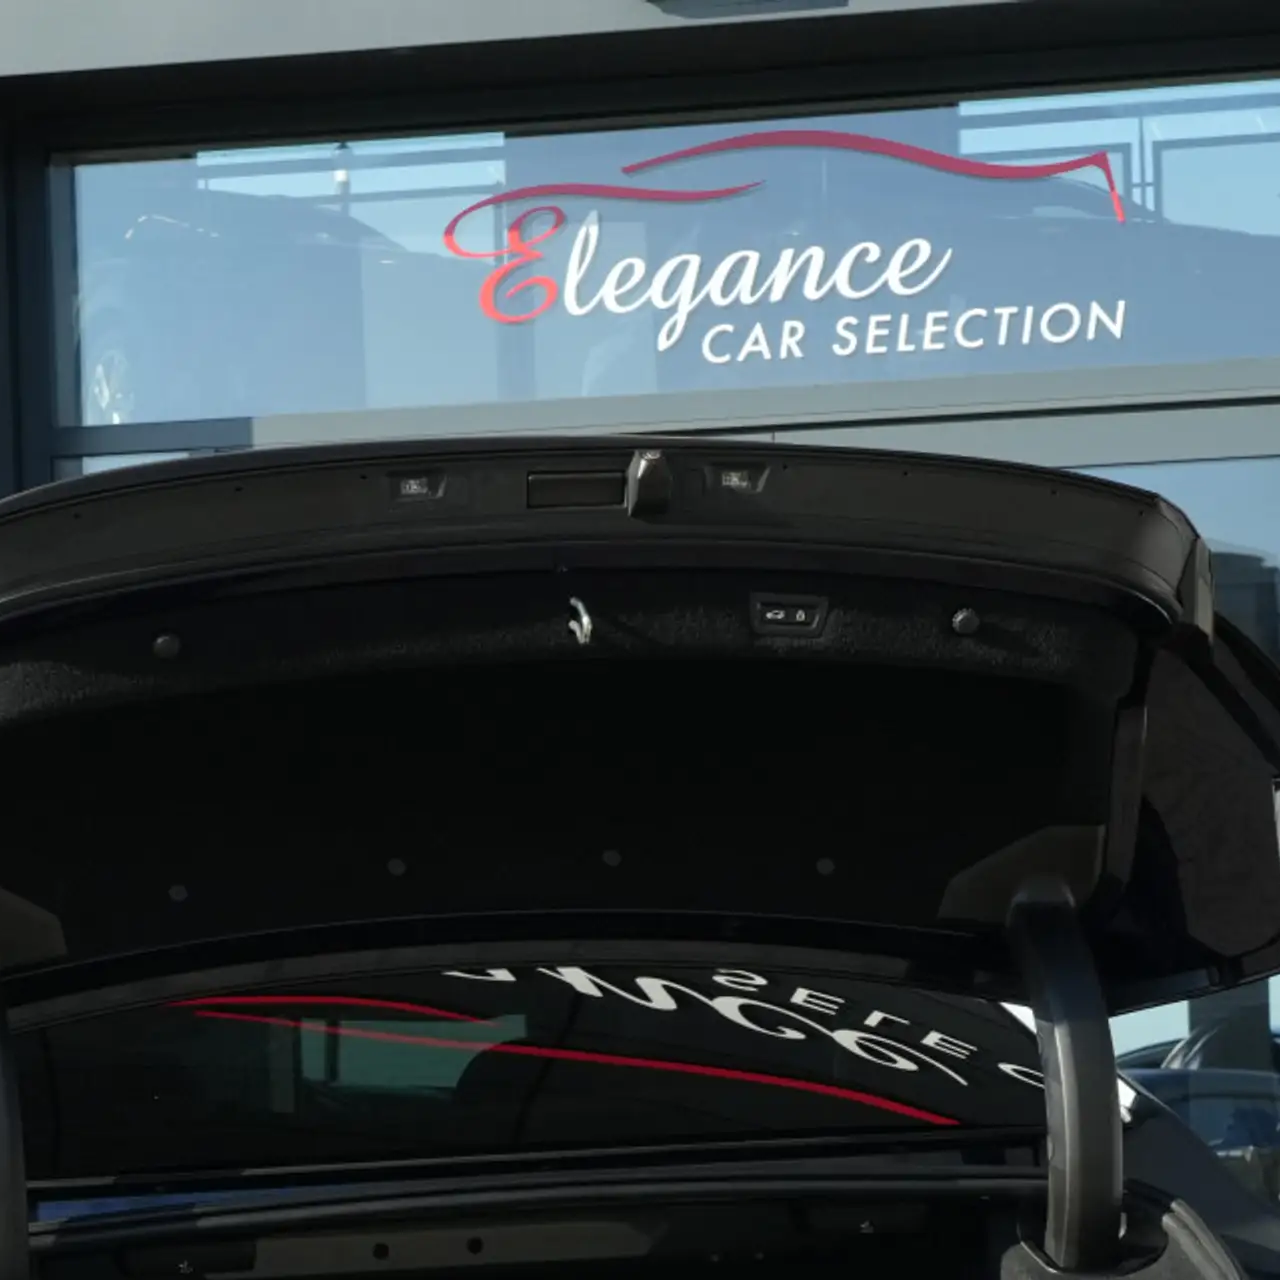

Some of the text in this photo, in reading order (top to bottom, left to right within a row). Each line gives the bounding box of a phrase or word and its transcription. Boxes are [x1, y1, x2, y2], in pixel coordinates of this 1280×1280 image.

[444, 202, 953, 351] Elegance
[703, 299, 1126, 364] CAR SELECTION
